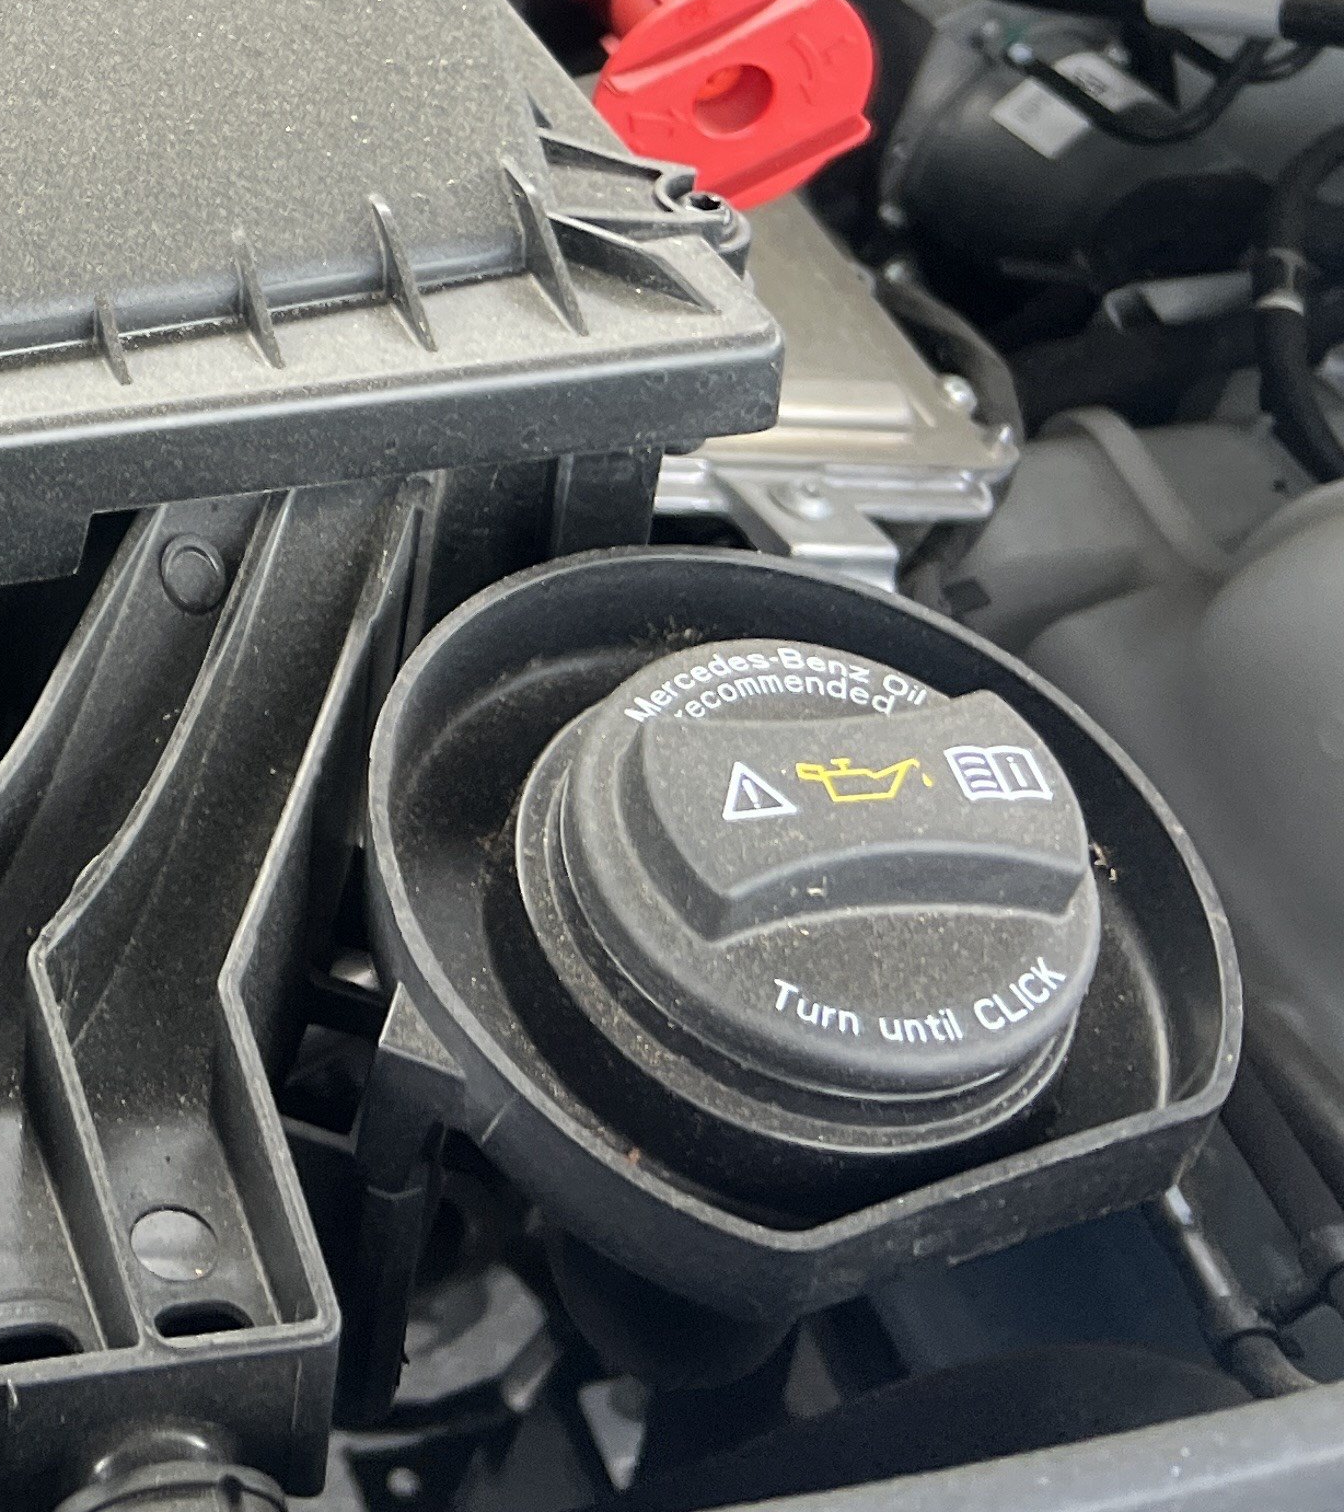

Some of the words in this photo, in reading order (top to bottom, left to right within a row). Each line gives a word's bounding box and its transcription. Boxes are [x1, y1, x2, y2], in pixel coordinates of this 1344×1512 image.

[624, 647, 871, 722] Mercedes-Benz
[882, 673, 928, 705] Oil
[773, 978, 860, 1037] Turn
[879, 1008, 964, 1042] until
[973, 956, 1067, 1031] CLICK
